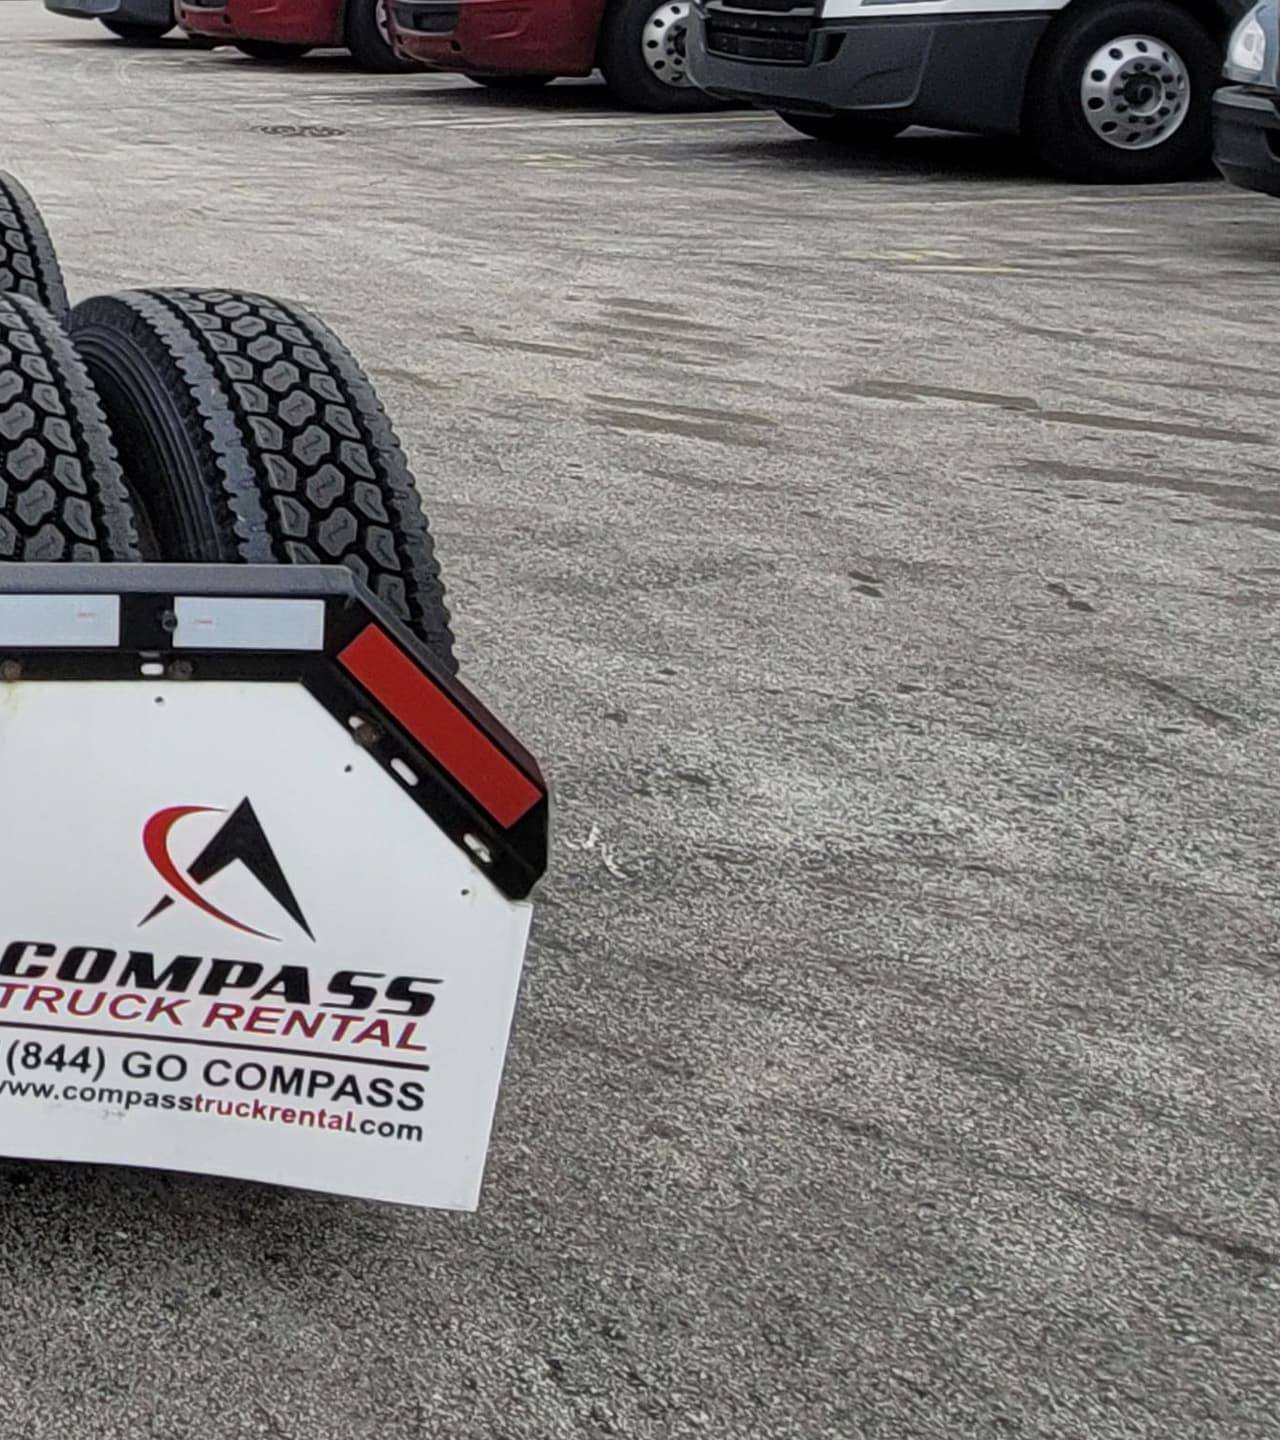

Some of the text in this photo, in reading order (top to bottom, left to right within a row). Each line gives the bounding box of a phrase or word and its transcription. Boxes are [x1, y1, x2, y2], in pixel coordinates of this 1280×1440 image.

[201, 1001, 428, 1052] RENTAL
[121, 1050, 188, 1083] GO
[202, 1058, 425, 1112] COMPASS
